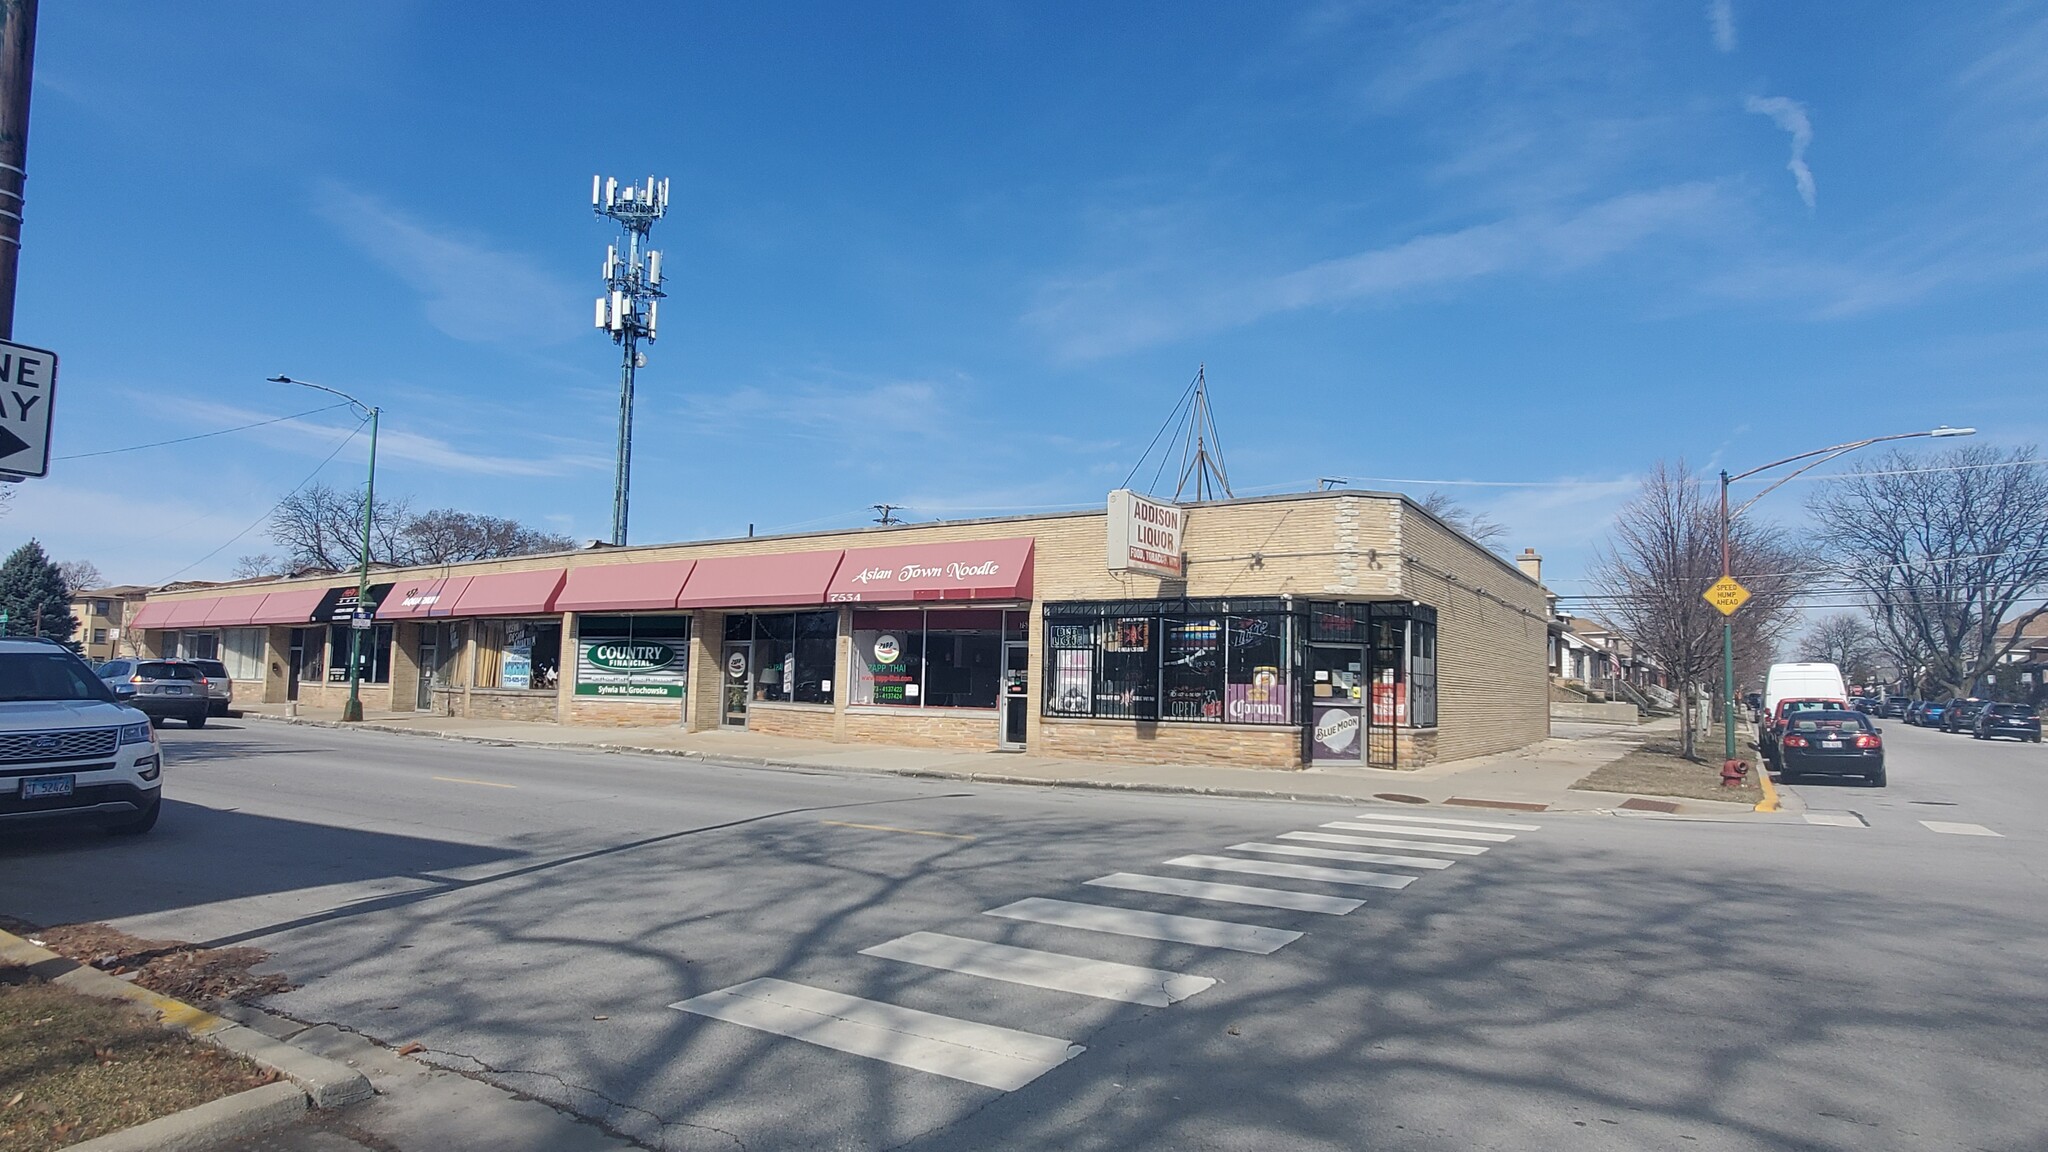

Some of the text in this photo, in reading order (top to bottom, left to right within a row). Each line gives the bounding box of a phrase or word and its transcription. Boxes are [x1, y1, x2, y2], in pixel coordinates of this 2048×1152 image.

[0, 353, 41, 389] NE
[1134, 501, 1178, 530] ADDISON
[1137, 524, 1174, 550] LIQUOR
[852, 560, 999, 584] Asian Town Noodle
[830, 593, 861, 602] 7534
[597, 645, 663, 659] COUNTRY
[868, 664, 907, 673] ZAPP THAI
[598, 686, 618, 695] Sylwia
[629, 687, 668, 695] Grochowska
[1171, 701, 1198, 717] OPEN
[1229, 699, 1284, 719] Corona
[1315, 718, 1358, 740] BLUE MOON
